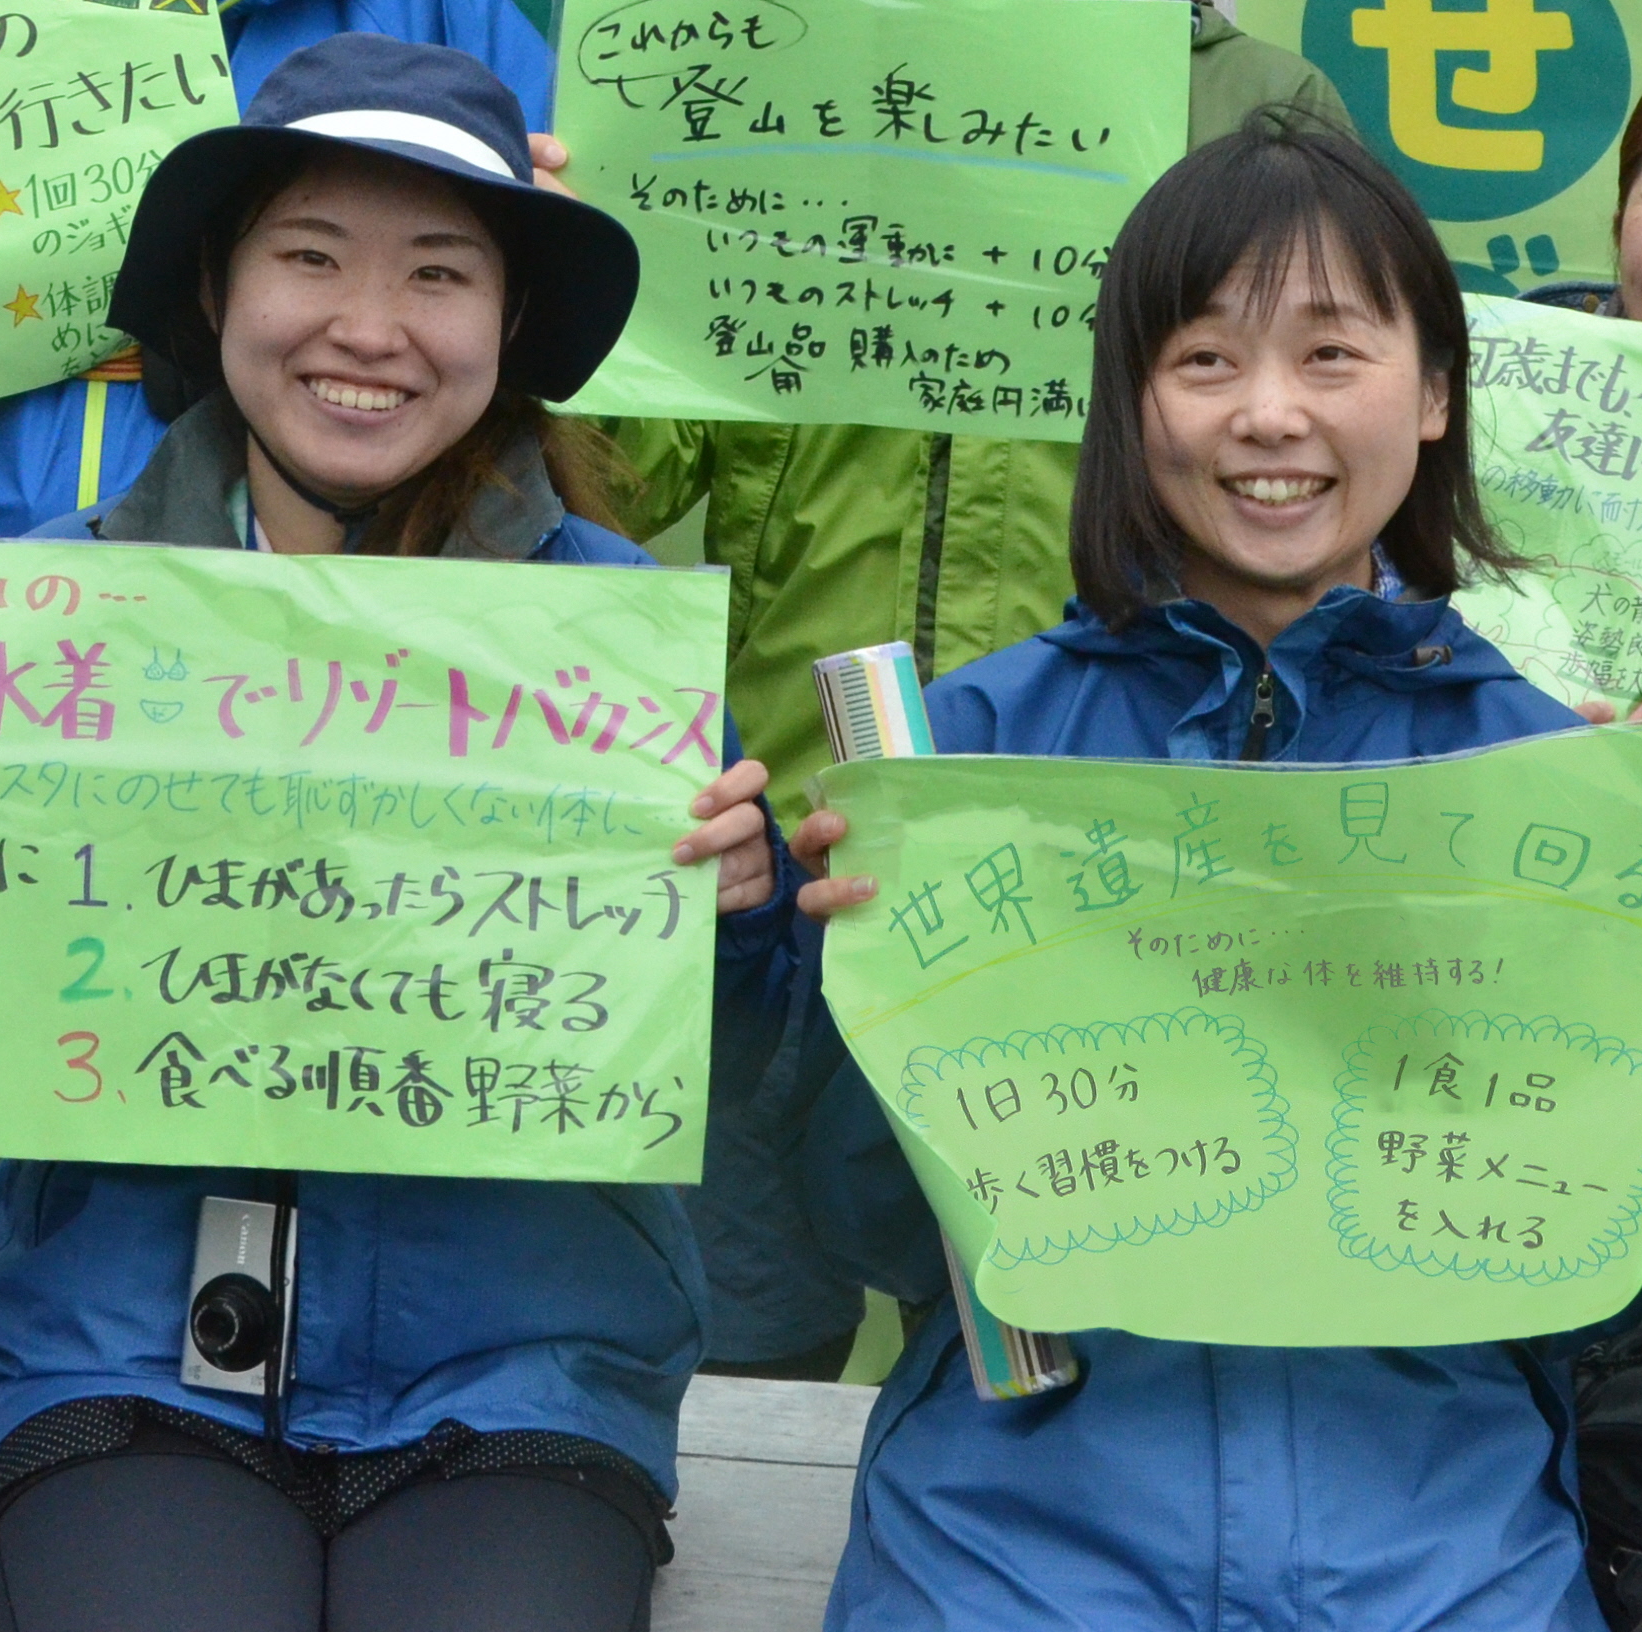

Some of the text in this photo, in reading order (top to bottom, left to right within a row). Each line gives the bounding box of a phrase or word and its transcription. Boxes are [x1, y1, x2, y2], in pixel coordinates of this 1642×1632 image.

[597, 10, 778, 60] これからも
[660, 62, 1111, 156] 登山を楽しみたい
[1191, 957, 1504, 998] 健康な体を維持する!
[967, 1136, 1243, 1215] 歩く習慣をつける
[1377, 1130, 1609, 1196] 野菜メニュー
[1397, 1197, 1547, 1250] を入れる
